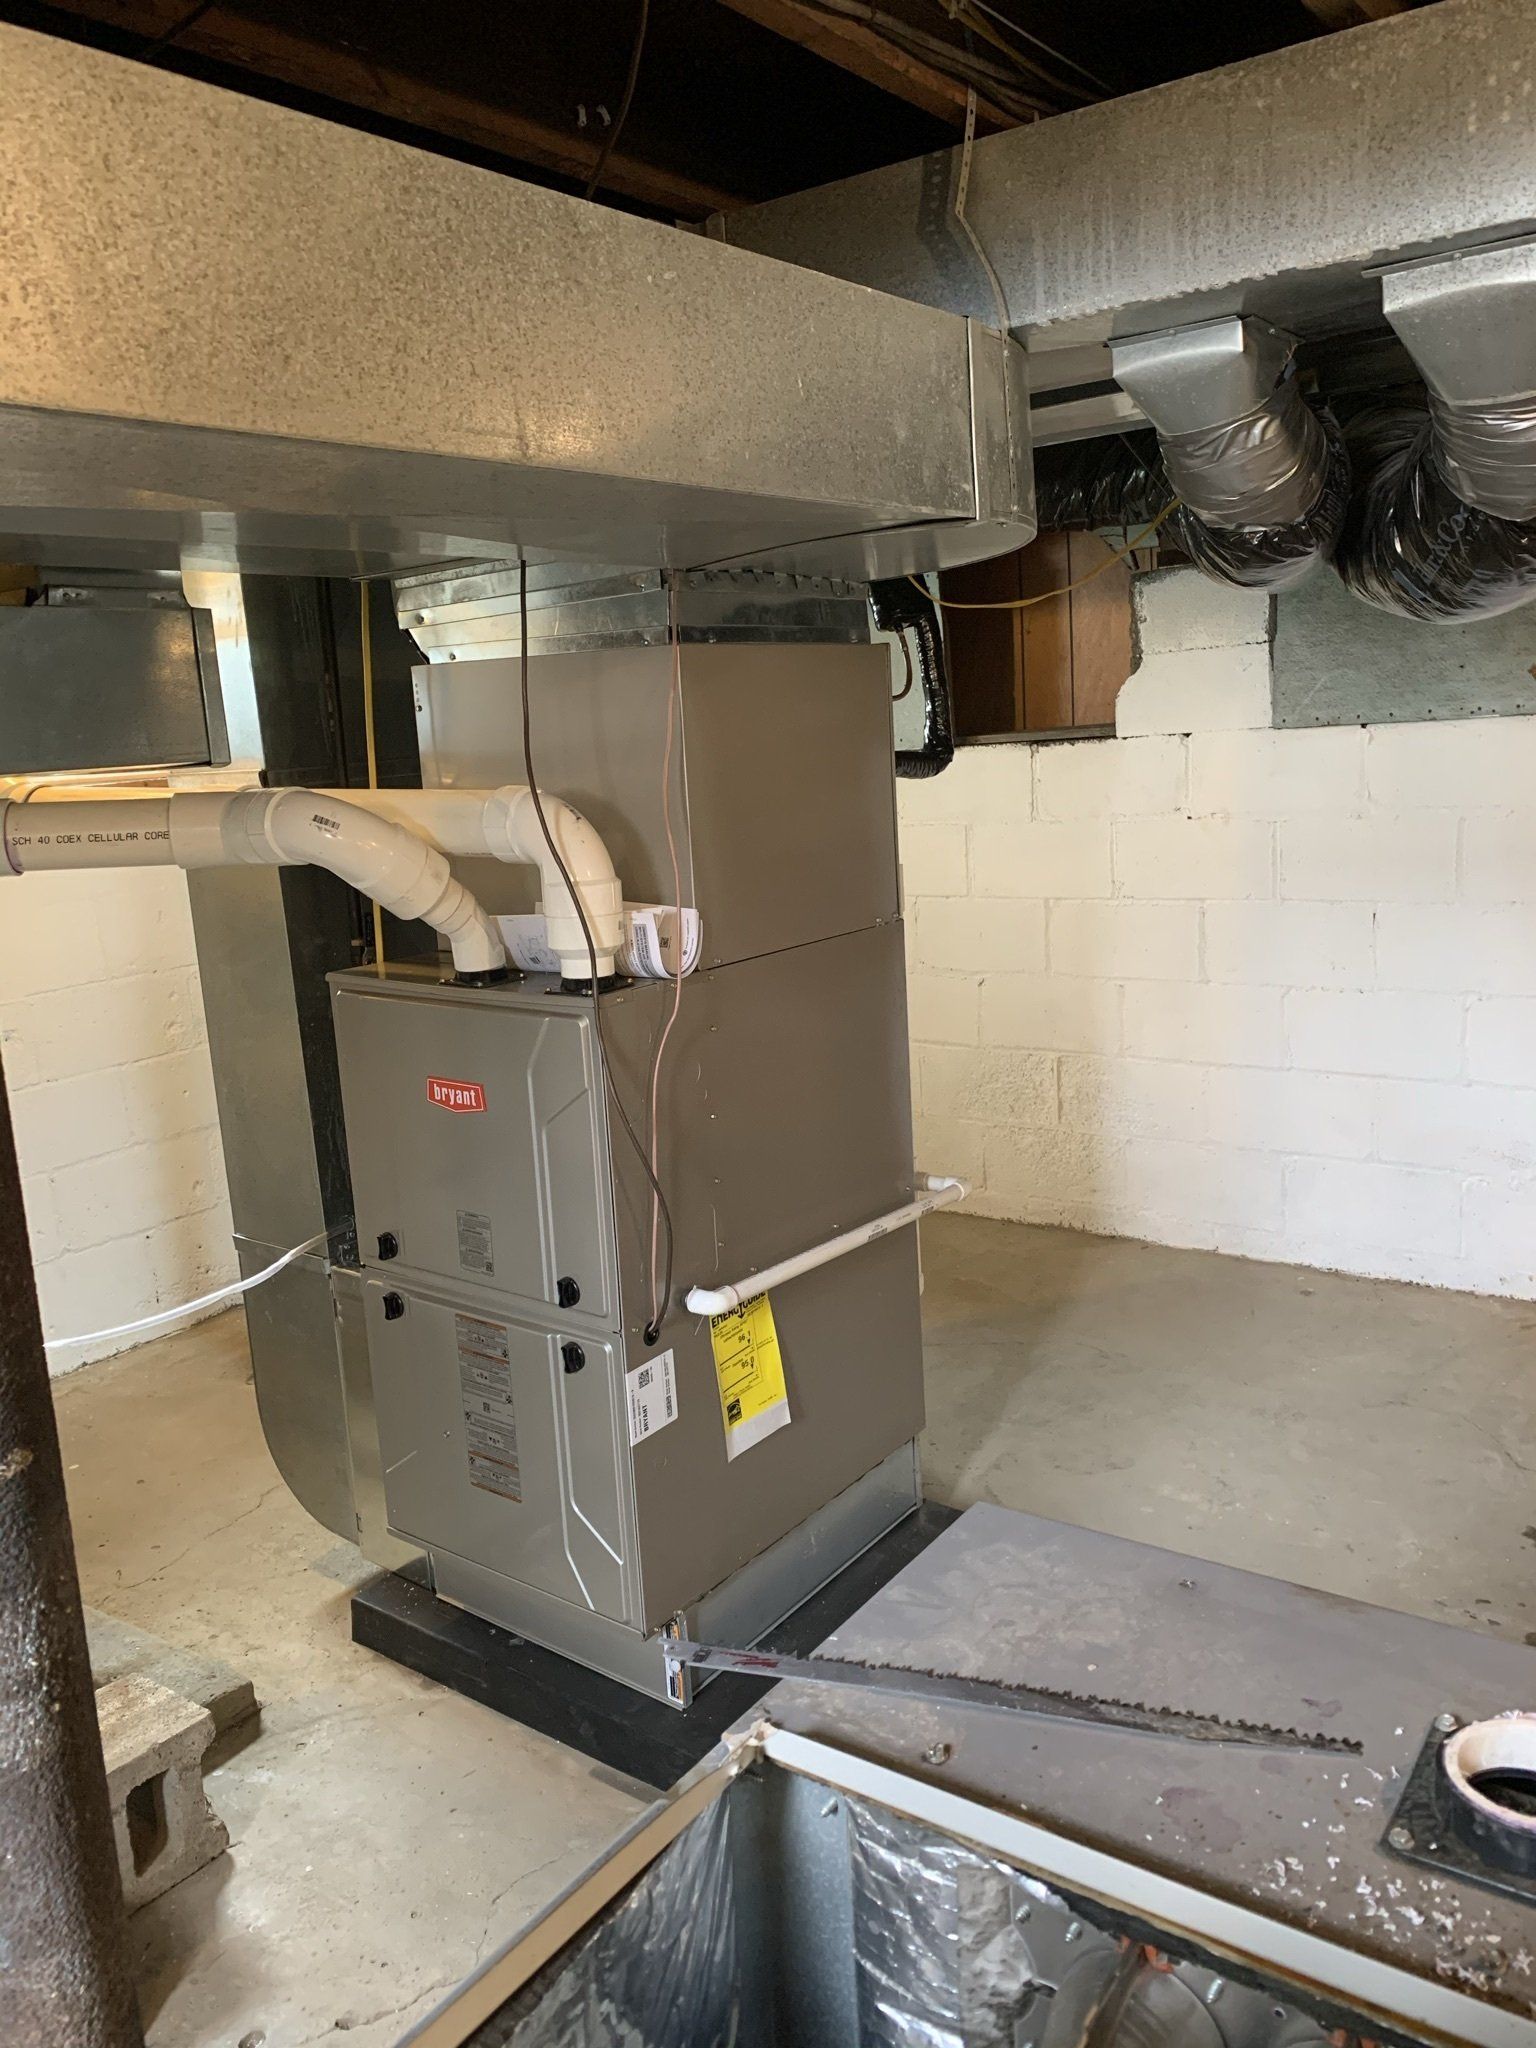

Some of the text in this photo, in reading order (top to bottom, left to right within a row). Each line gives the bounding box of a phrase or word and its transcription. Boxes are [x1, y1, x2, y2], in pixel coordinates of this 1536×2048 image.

[12, 830, 170, 846] SCH 40 COEX CELLULAR CORE
[433, 1083, 477, 1107] bryant
